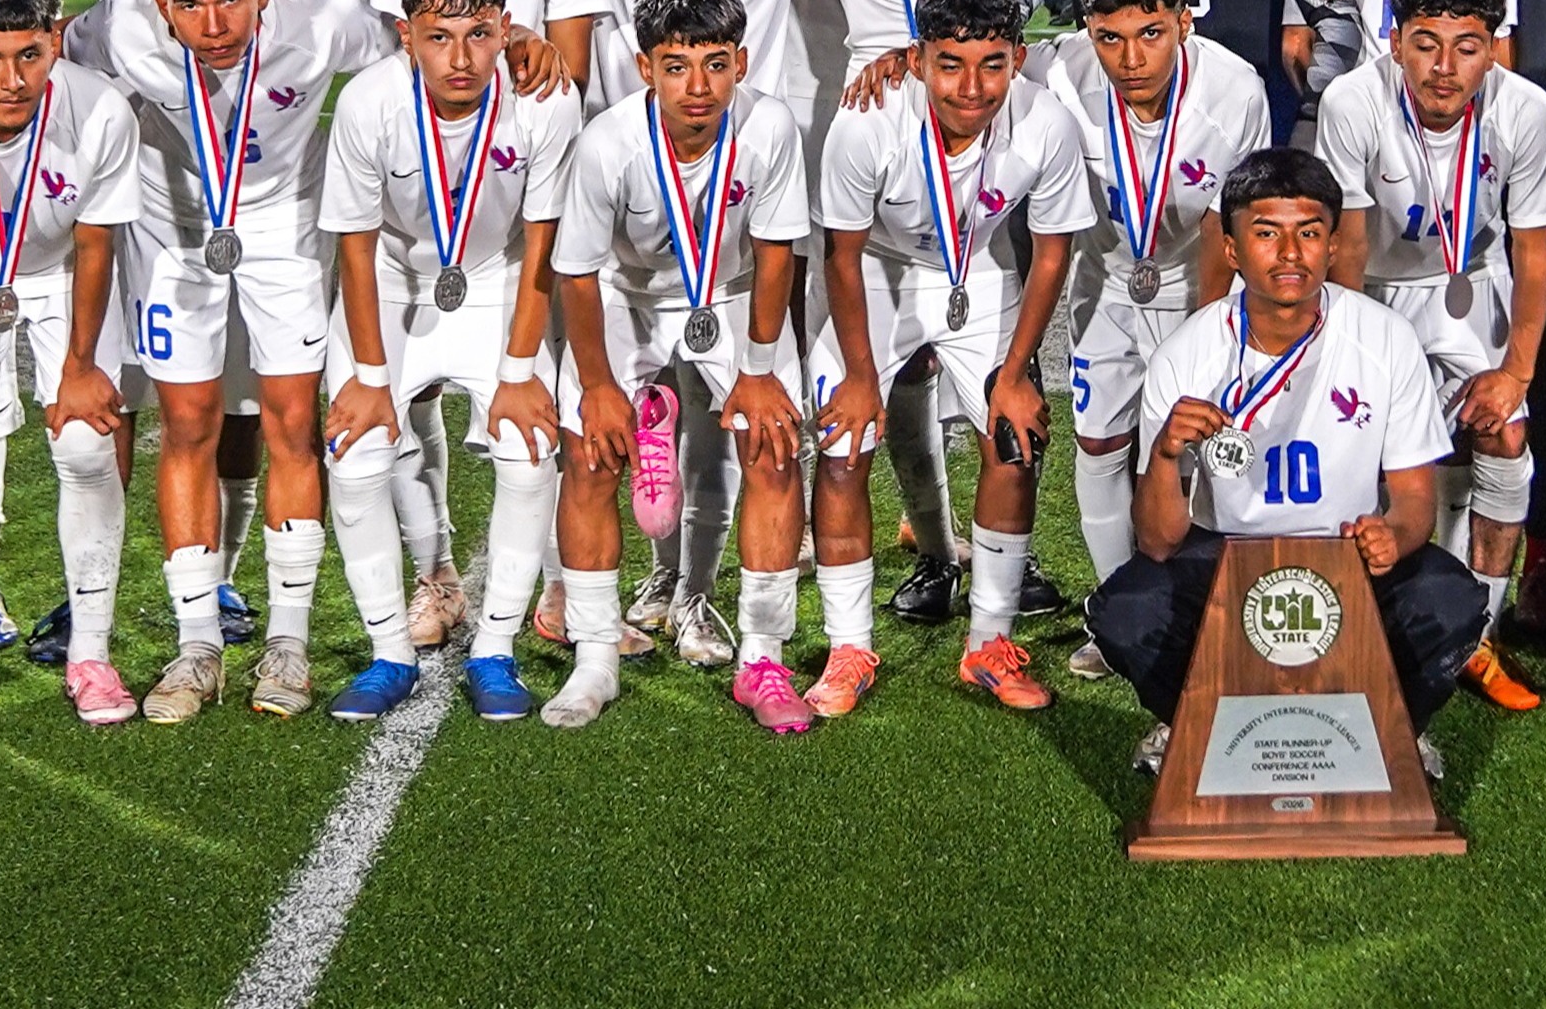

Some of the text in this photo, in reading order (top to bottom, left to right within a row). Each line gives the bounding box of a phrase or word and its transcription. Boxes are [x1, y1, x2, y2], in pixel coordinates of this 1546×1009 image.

[135, 299, 172, 360] 16
[1072, 356, 1091, 413] 5
[1215, 441, 1244, 465] UIL
[1264, 440, 1322, 504] 10
[1262, 594, 1321, 631] UIL
[1272, 633, 1310, 643] STATE
[1224, 706, 1362, 756] UNIVERSITY INTERSCHOLASTIC LEAGUE
[1254, 738, 1333, 749] STATE RUNNER-UP
[1289, 750, 1326, 759] SOCCER
[1251, 761, 1336, 771] CONFERENCE AAAA
[1272, 773, 1309, 782] DIVISION
